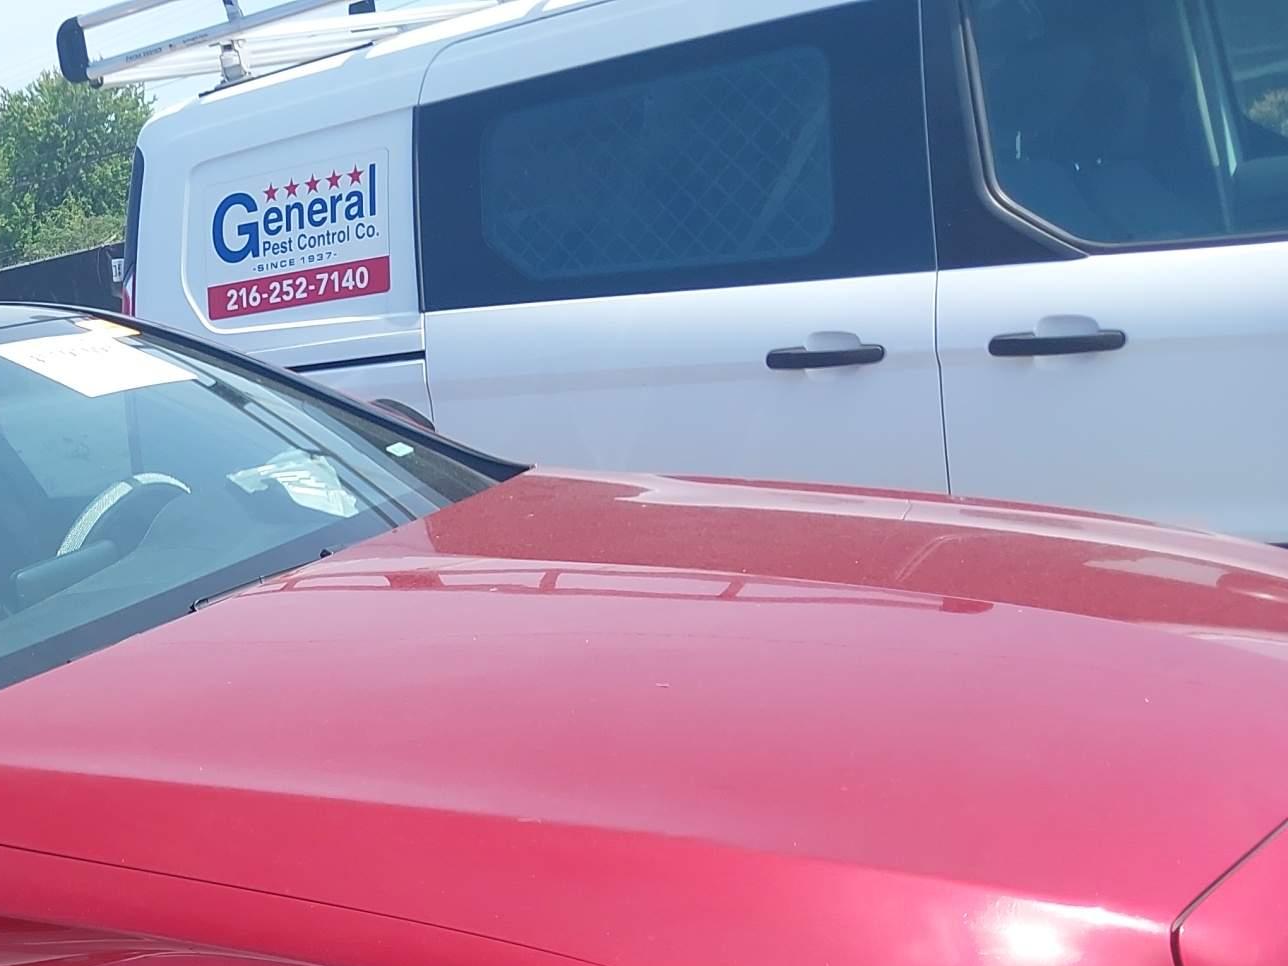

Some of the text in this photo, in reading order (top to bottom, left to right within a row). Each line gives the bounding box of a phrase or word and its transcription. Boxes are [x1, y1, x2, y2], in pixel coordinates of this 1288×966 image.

[212, 163, 377, 263] General
[263, 222, 380, 256] Pest Control Co.
[226, 266, 369, 311] 216-252-7140
